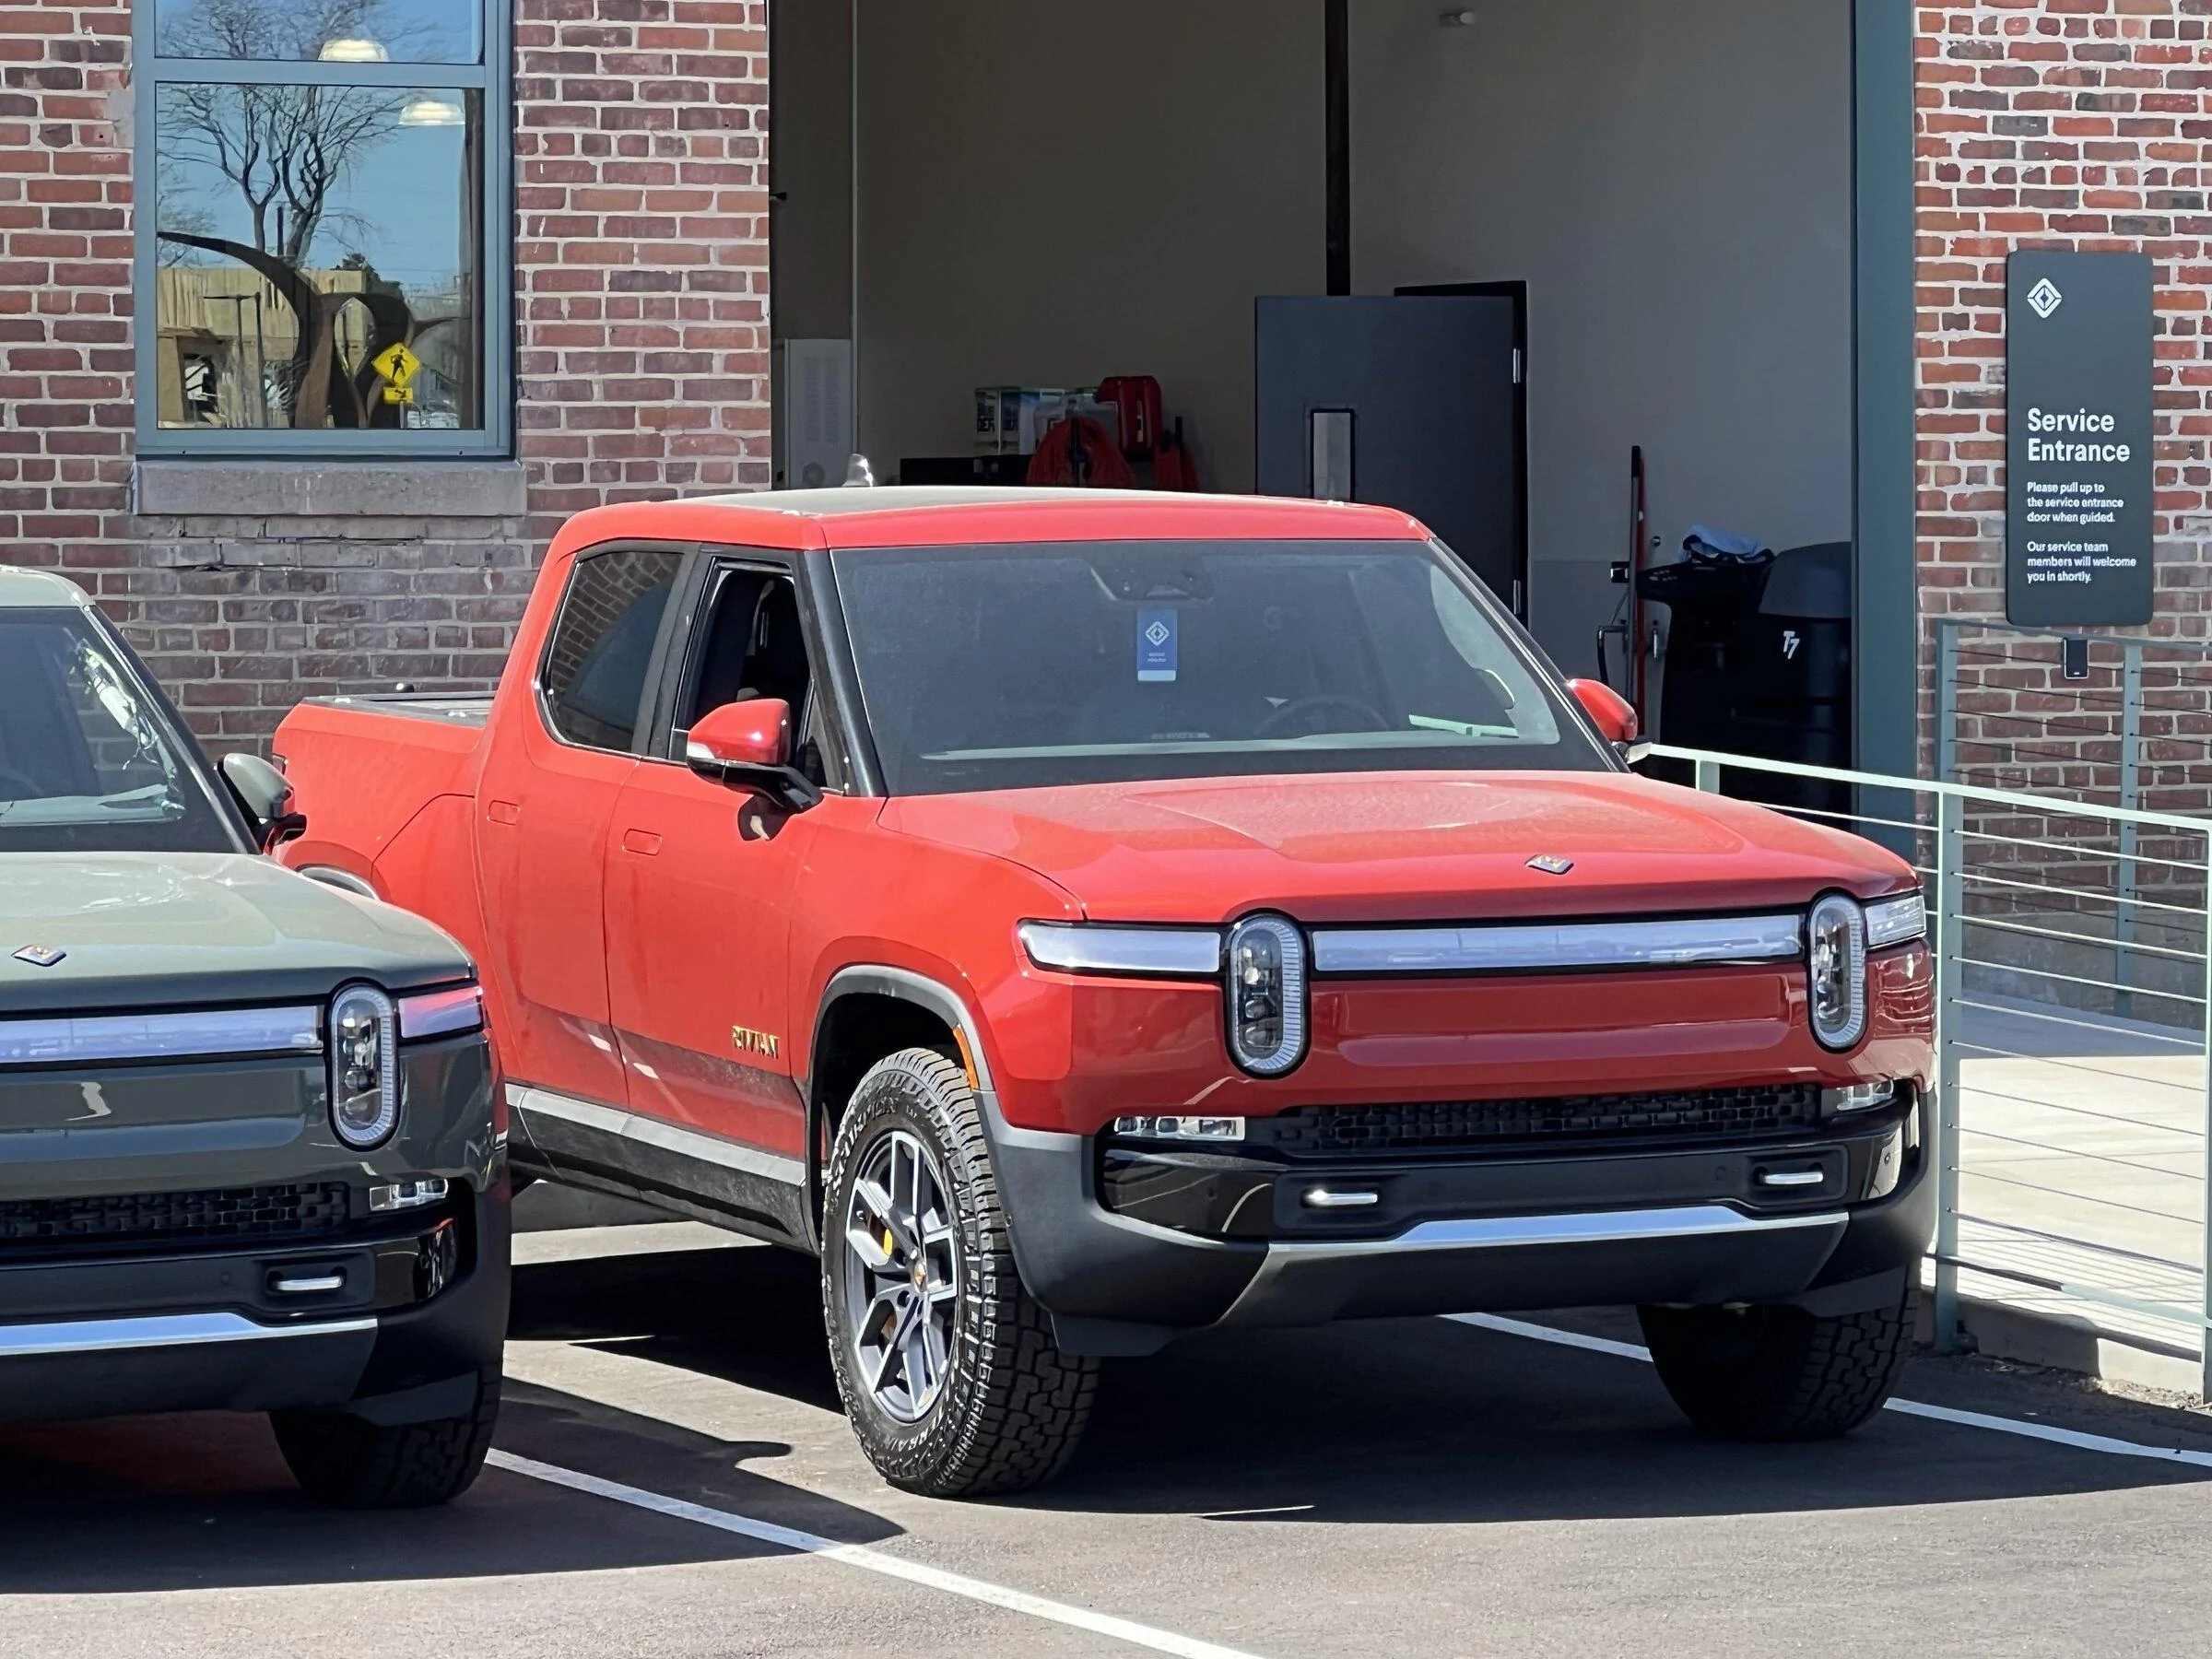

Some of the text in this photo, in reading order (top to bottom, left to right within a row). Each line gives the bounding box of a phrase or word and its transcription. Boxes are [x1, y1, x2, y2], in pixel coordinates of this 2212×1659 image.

[2028, 407, 2114, 432] Service
[2028, 437, 2130, 463] Entrance
[2027, 481, 2105, 495] Please pull up to
[2027, 496, 2124, 507] the service entrance
[2027, 512, 2115, 524] door when guided.
[2027, 541, 2109, 552] Our service team
[2027, 556, 2136, 567] members will welcome
[2027, 571, 2092, 584] you in shortly.
